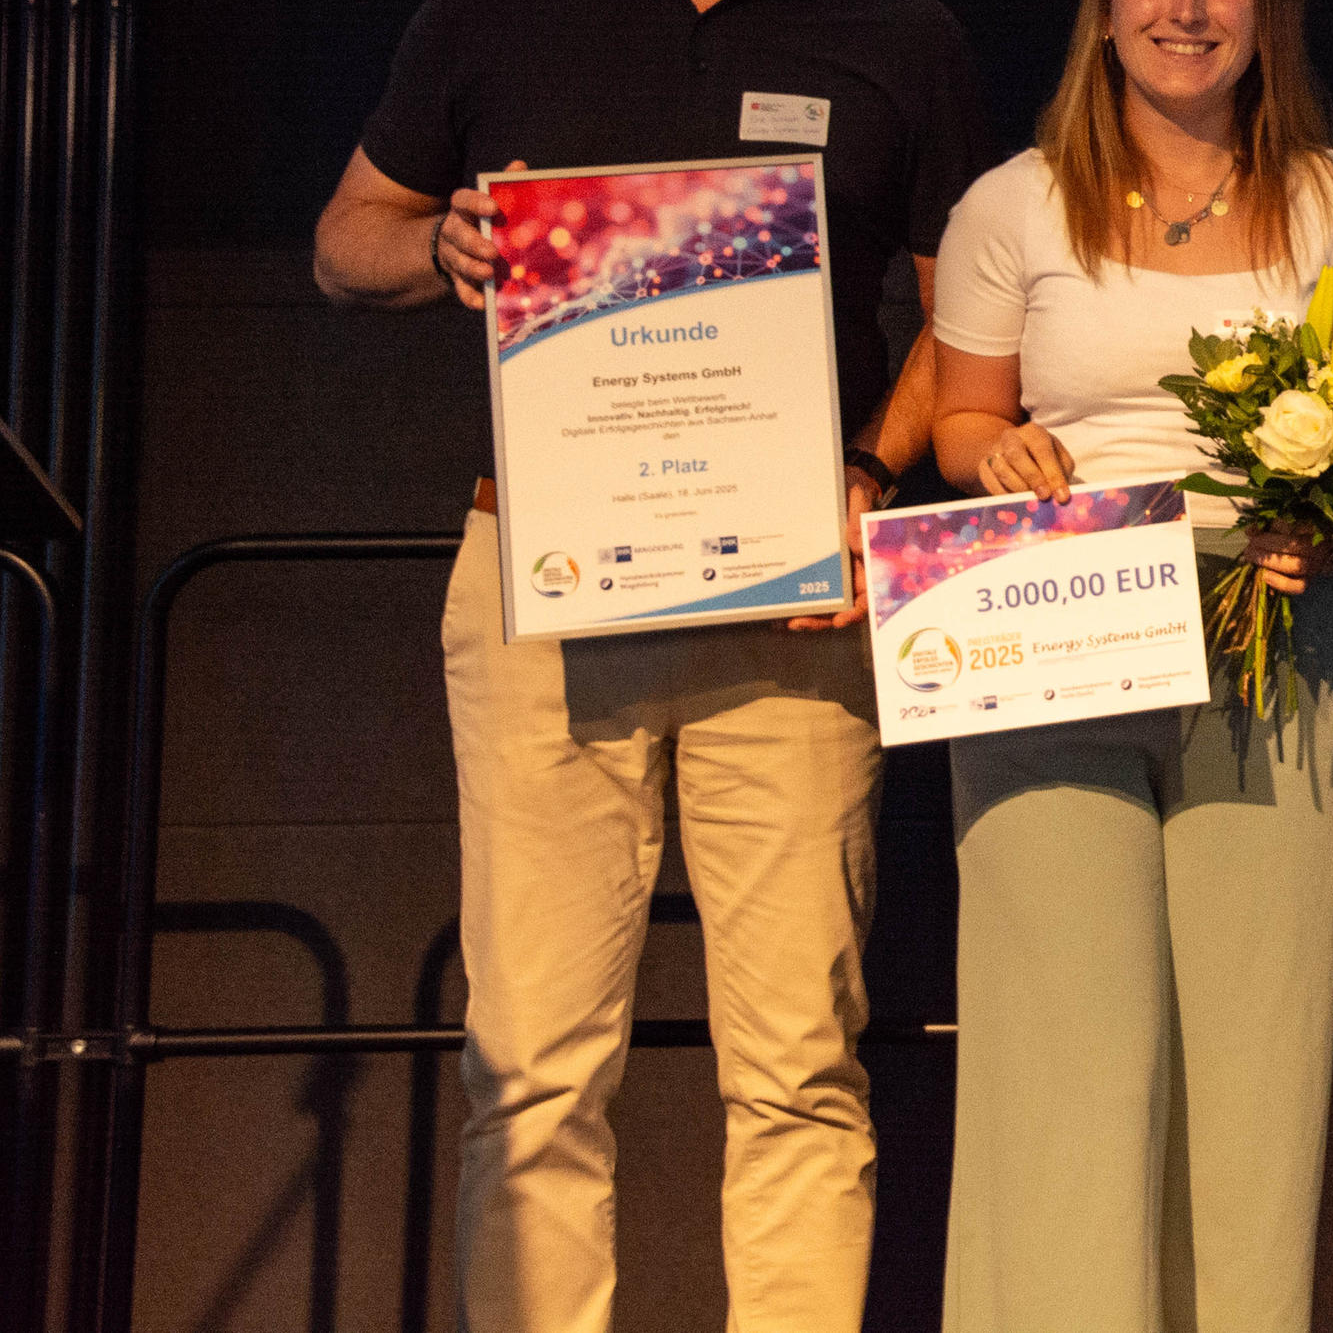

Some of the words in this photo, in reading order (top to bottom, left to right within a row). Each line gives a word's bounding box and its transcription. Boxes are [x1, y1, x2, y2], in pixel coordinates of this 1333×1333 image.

[611, 321, 718, 347] Urkunde
[592, 376, 639, 388] Energy
[642, 371, 698, 385] Systems
[701, 365, 742, 379] GmbH
[638, 462, 655, 477] 2.
[662, 459, 709, 475] Platz
[800, 581, 829, 595] 2025
[976, 572, 1105, 612] 3.000,00
[1116, 563, 1179, 593] EUR
[1032, 639, 1084, 654] Energy
[1086, 631, 1141, 648] Systems
[1144, 621, 1188, 638] GmbH
[970, 643, 1024, 671] 2025
